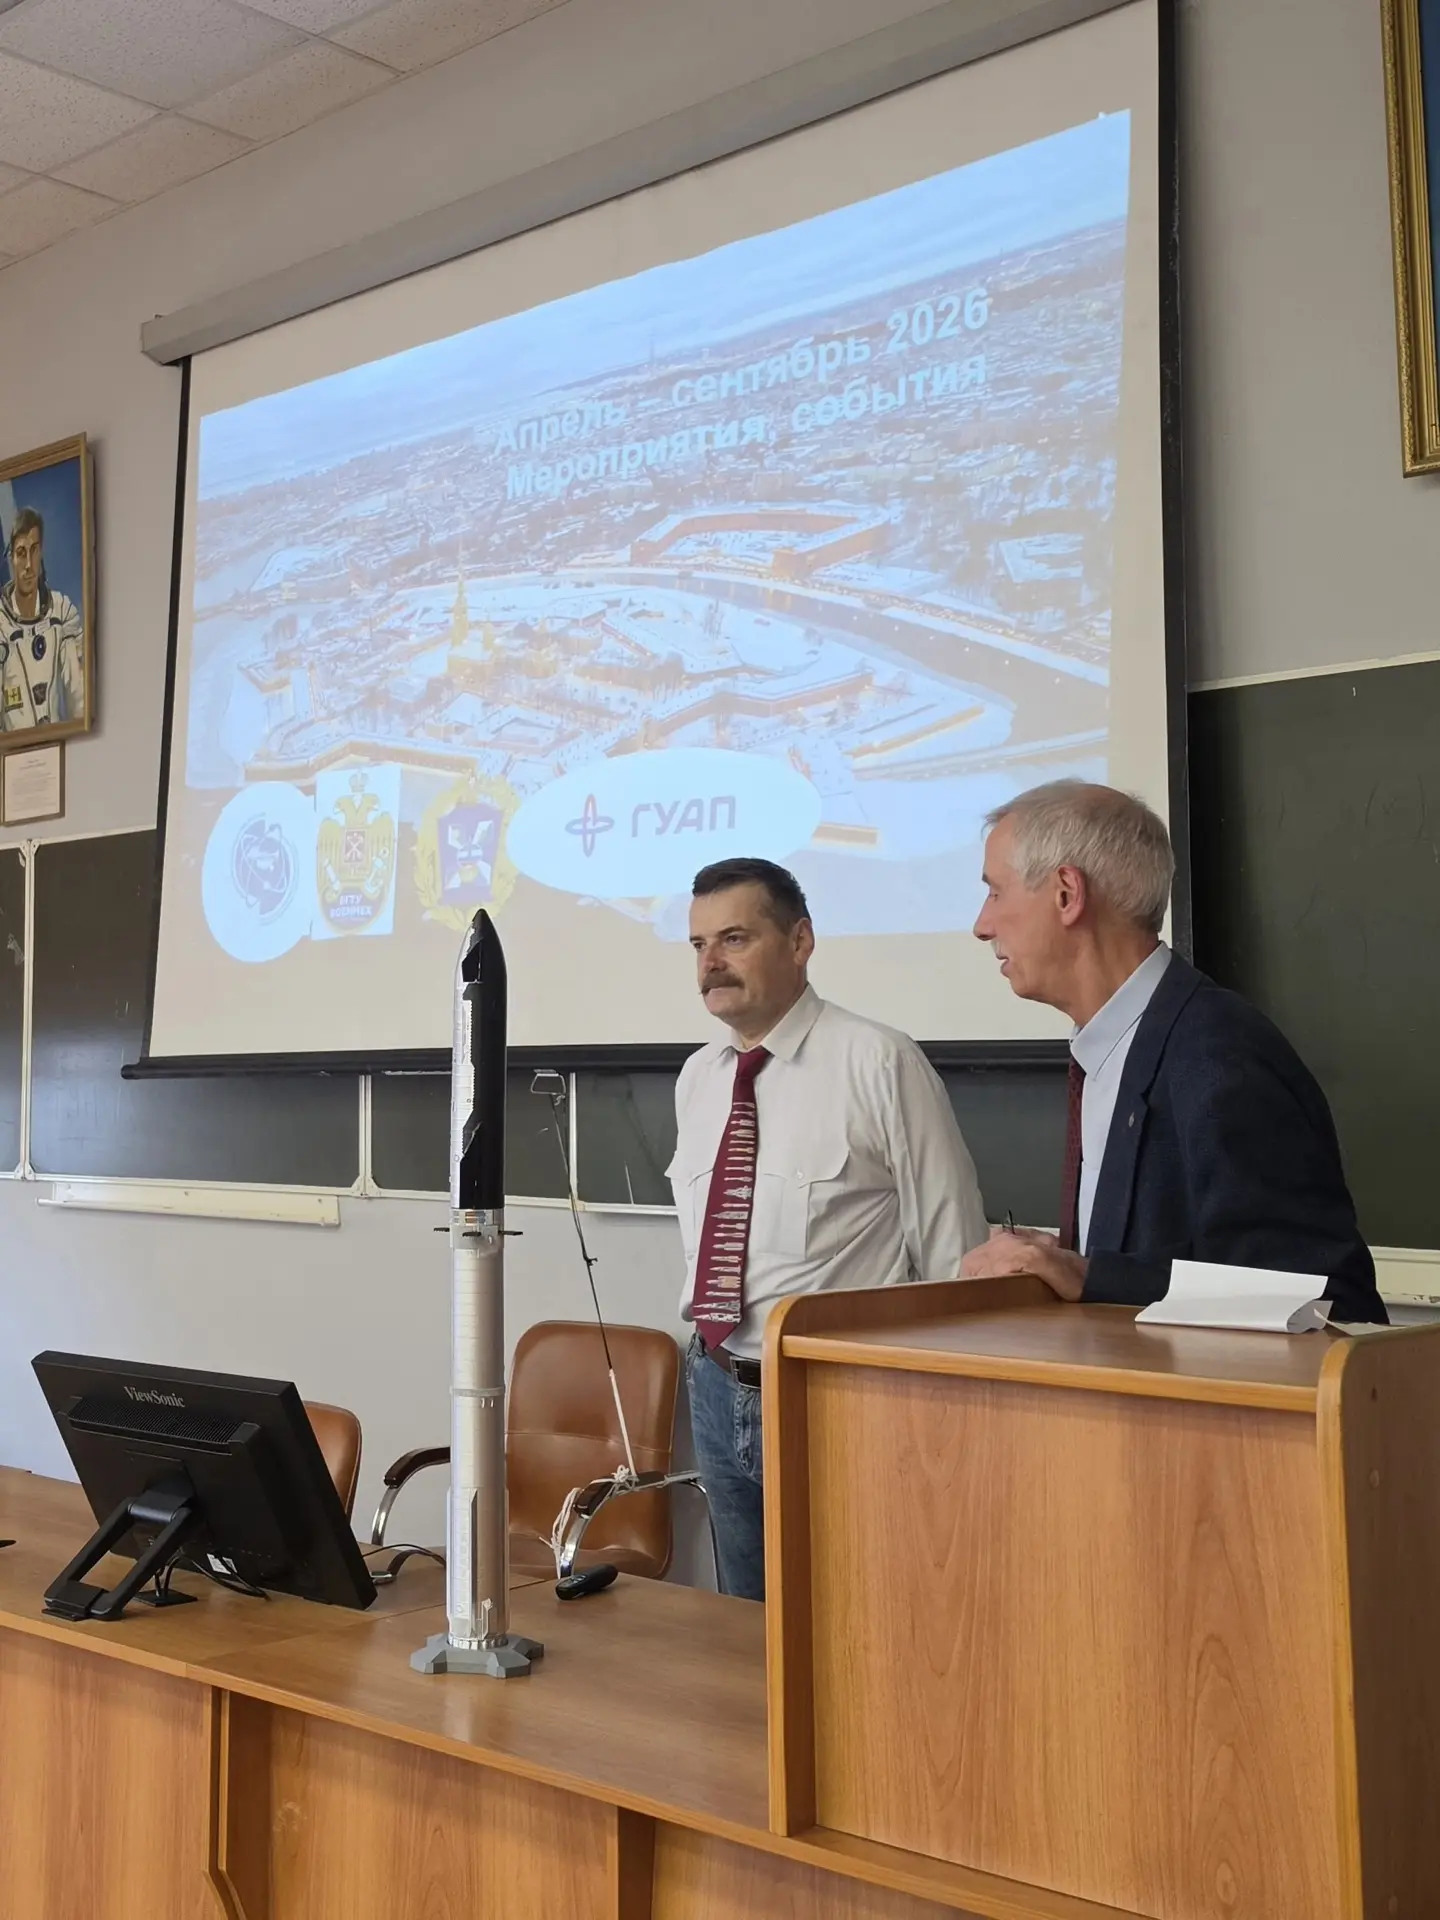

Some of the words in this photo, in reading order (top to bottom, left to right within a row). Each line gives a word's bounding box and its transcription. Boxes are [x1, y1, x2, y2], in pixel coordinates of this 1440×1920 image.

[493, 401, 627, 457] Апрель
[671, 335, 871, 408] сентябрь
[886, 288, 990, 354] 2026
[506, 414, 777, 501] Мероприятия,
[791, 353, 986, 432] события
[631, 795, 736, 838] ГУАП
[123, 1385, 186, 1408] ViewSonic
